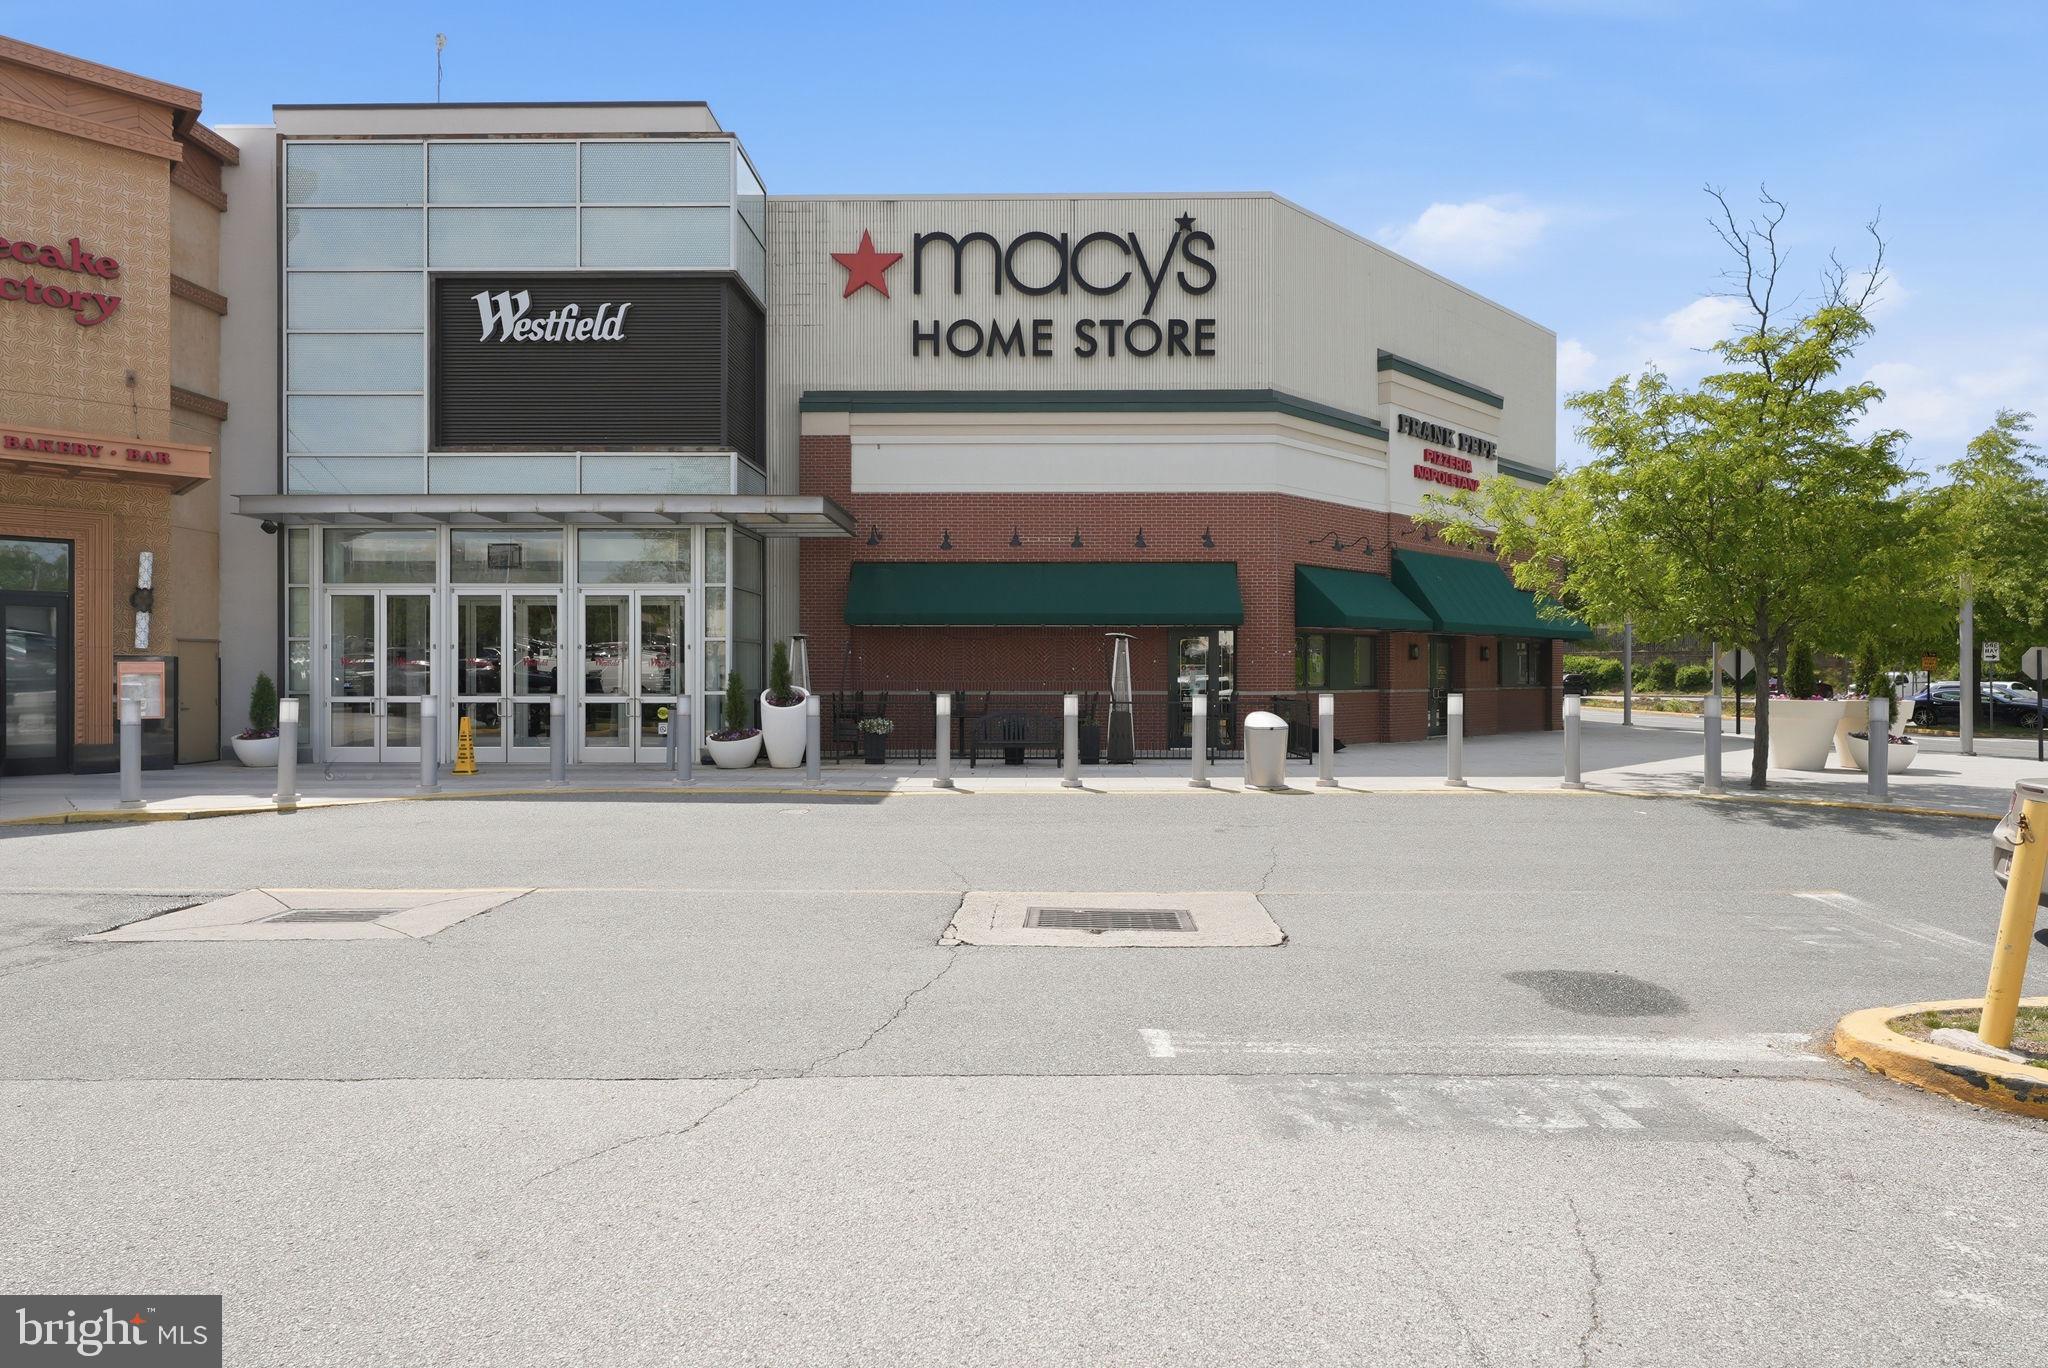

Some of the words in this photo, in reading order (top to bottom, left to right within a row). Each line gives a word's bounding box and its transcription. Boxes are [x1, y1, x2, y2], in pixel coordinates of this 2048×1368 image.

[0, 275, 122, 327] ctory
[471, 289, 632, 343] Westfield
[912, 318, 1054, 357] HOME
[1075, 318, 1216, 357] STORE
[3, 435, 104, 458] BAKERY
[126, 448, 172, 465] BAR
[1397, 413, 1456, 449] FRANK
[1458, 432, 1498, 461] PEPE
[1423, 448, 1473, 474] PIZZERIA
